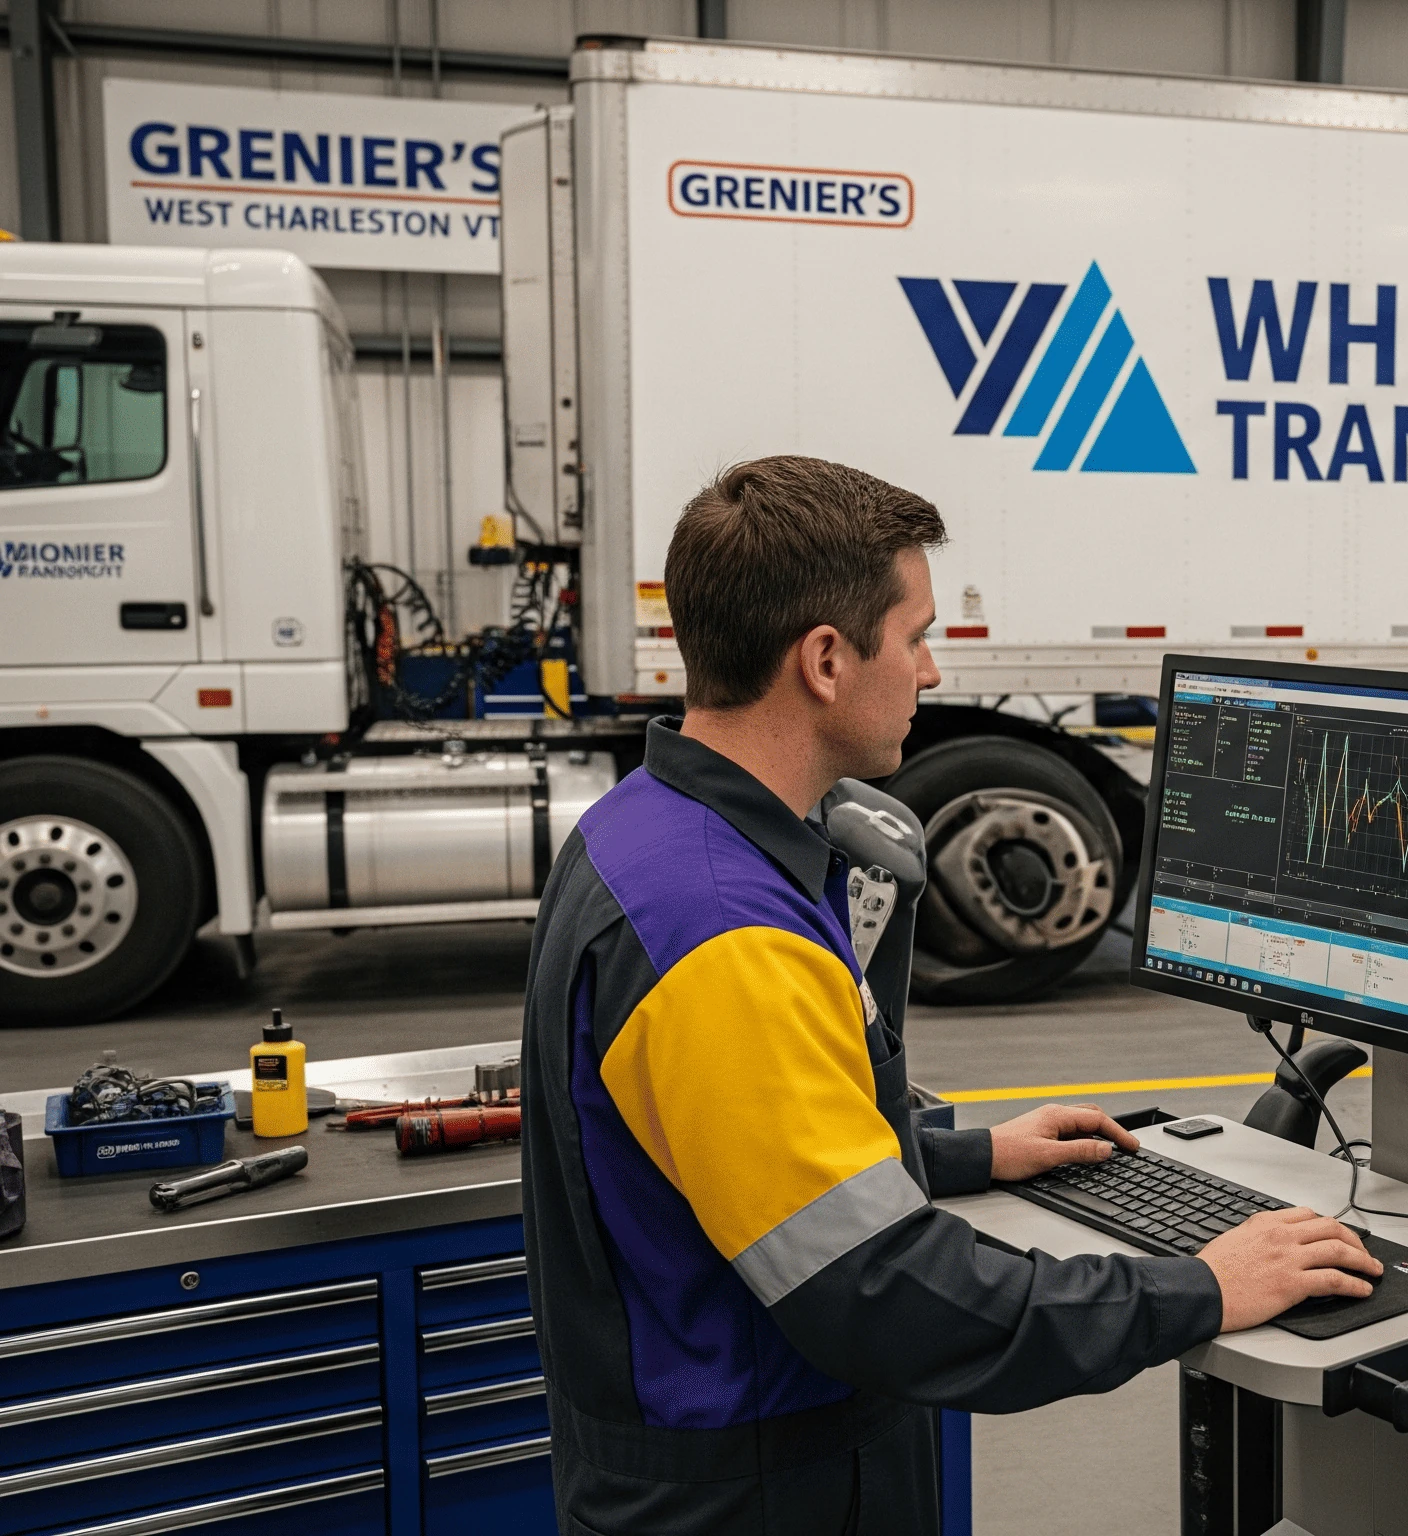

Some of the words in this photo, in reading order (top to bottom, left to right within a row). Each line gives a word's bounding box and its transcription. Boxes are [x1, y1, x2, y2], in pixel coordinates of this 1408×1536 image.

[130, 122, 501, 193] GRENIER'S
[680, 173, 901, 217] GRENIER'S
[144, 198, 233, 227] WEST
[243, 203, 450, 237] CHARLESTON
[463, 215, 501, 238] VT
